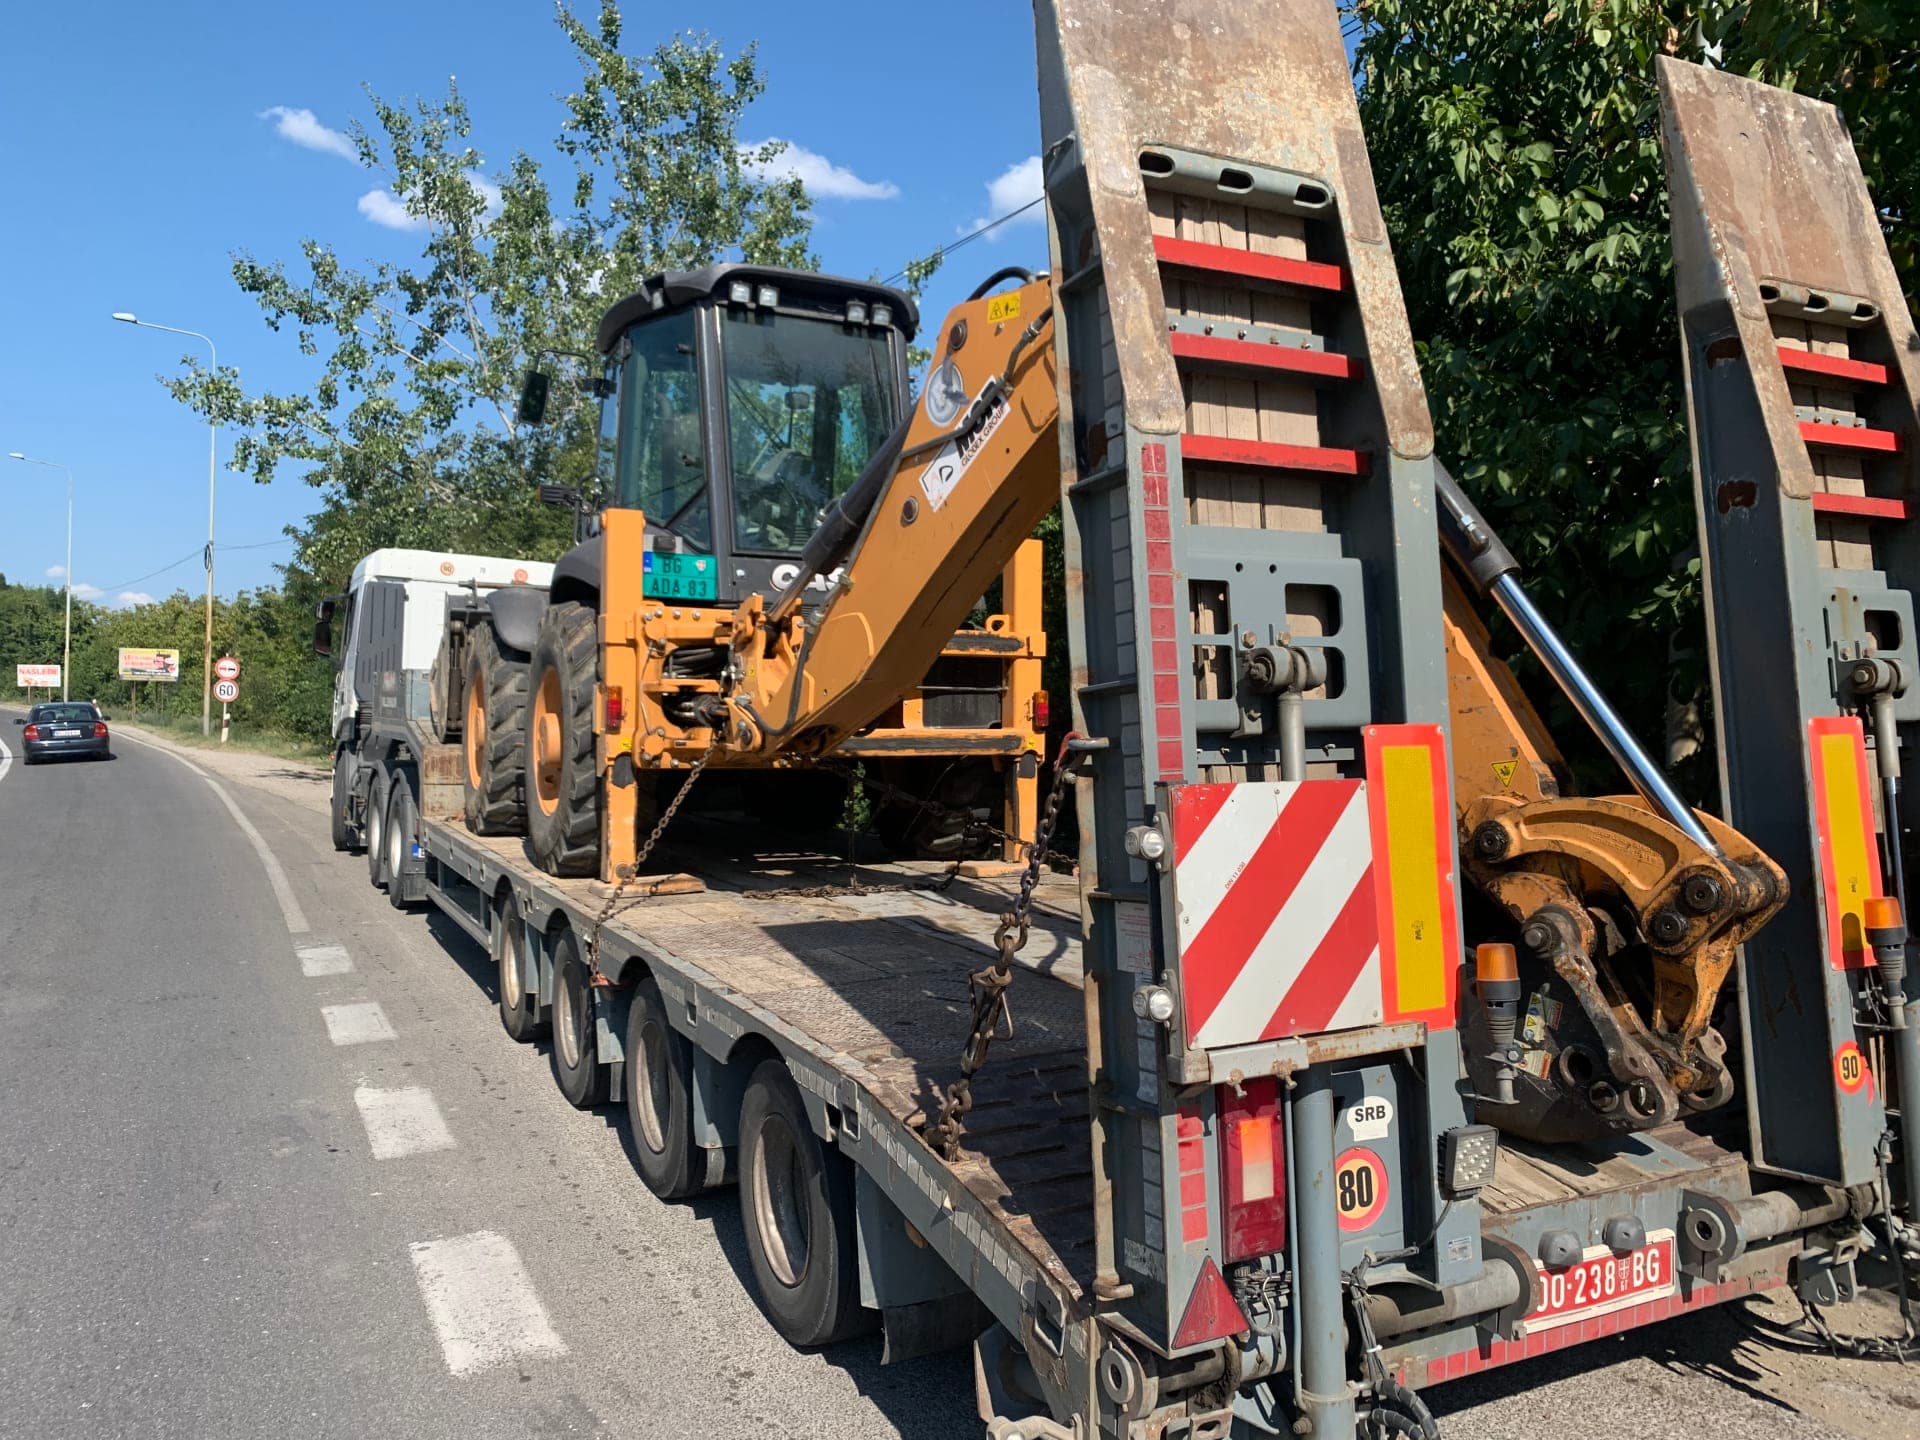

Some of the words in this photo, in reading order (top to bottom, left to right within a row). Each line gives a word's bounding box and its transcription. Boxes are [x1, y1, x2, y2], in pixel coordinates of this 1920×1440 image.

[983, 405, 1005, 437] GROUP
[662, 557, 682, 574] BG
[770, 563, 846, 592] CAS
[219, 684, 234, 697] 60
[1842, 1055, 1859, 1080] 90
[1354, 1105, 1386, 1122] SRB
[1338, 1166, 1374, 1212] 80
[1632, 1248, 1661, 1288] BG
